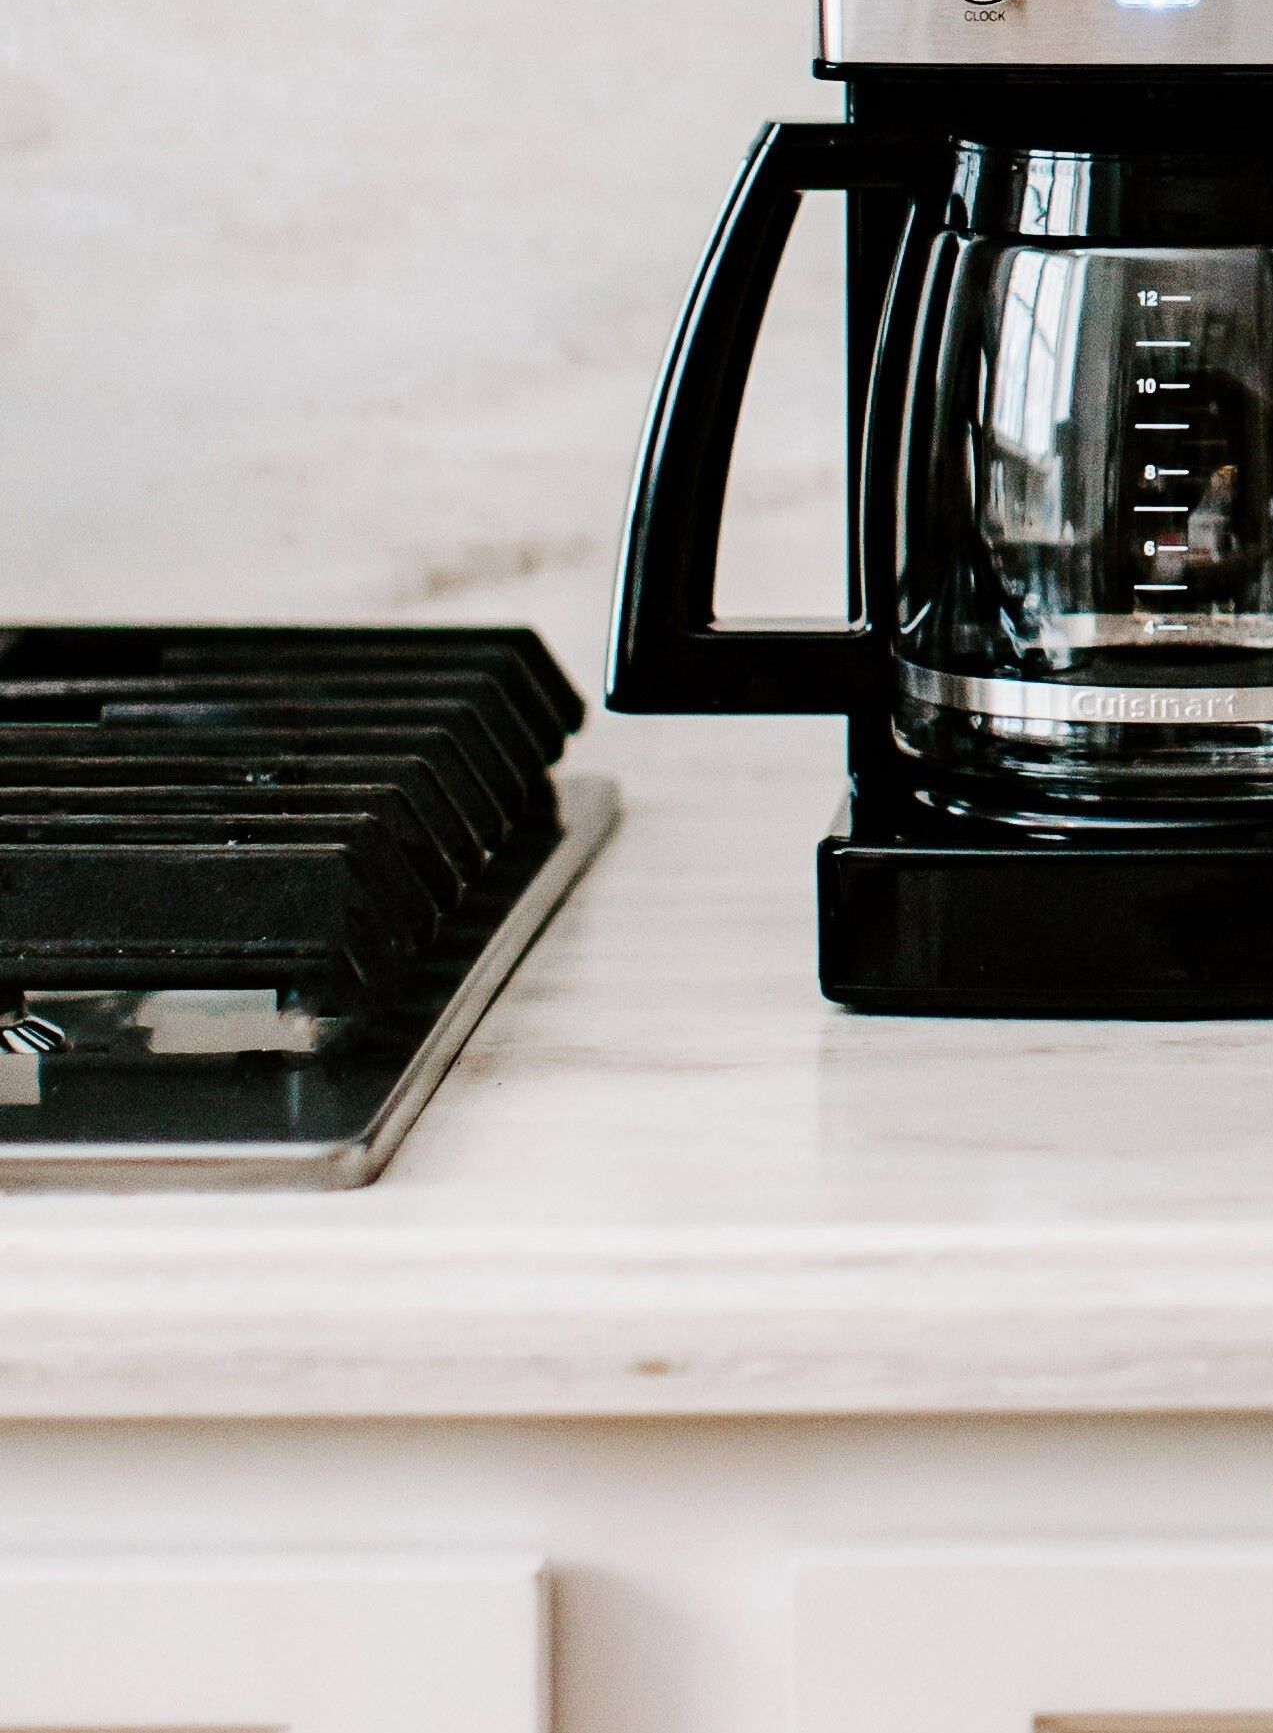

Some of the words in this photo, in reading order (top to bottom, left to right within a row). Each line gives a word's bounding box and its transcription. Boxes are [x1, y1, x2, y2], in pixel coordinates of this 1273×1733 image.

[964, 10, 1007, 22] CLOCK
[1136, 290, 1159, 307] 12
[1136, 377, 1157, 394] 10
[1143, 464, 1156, 480] 8
[1143, 540, 1156, 557] 6
[1143, 620, 1155, 635] 4
[1071, 690, 1237, 719] Cuisinart
